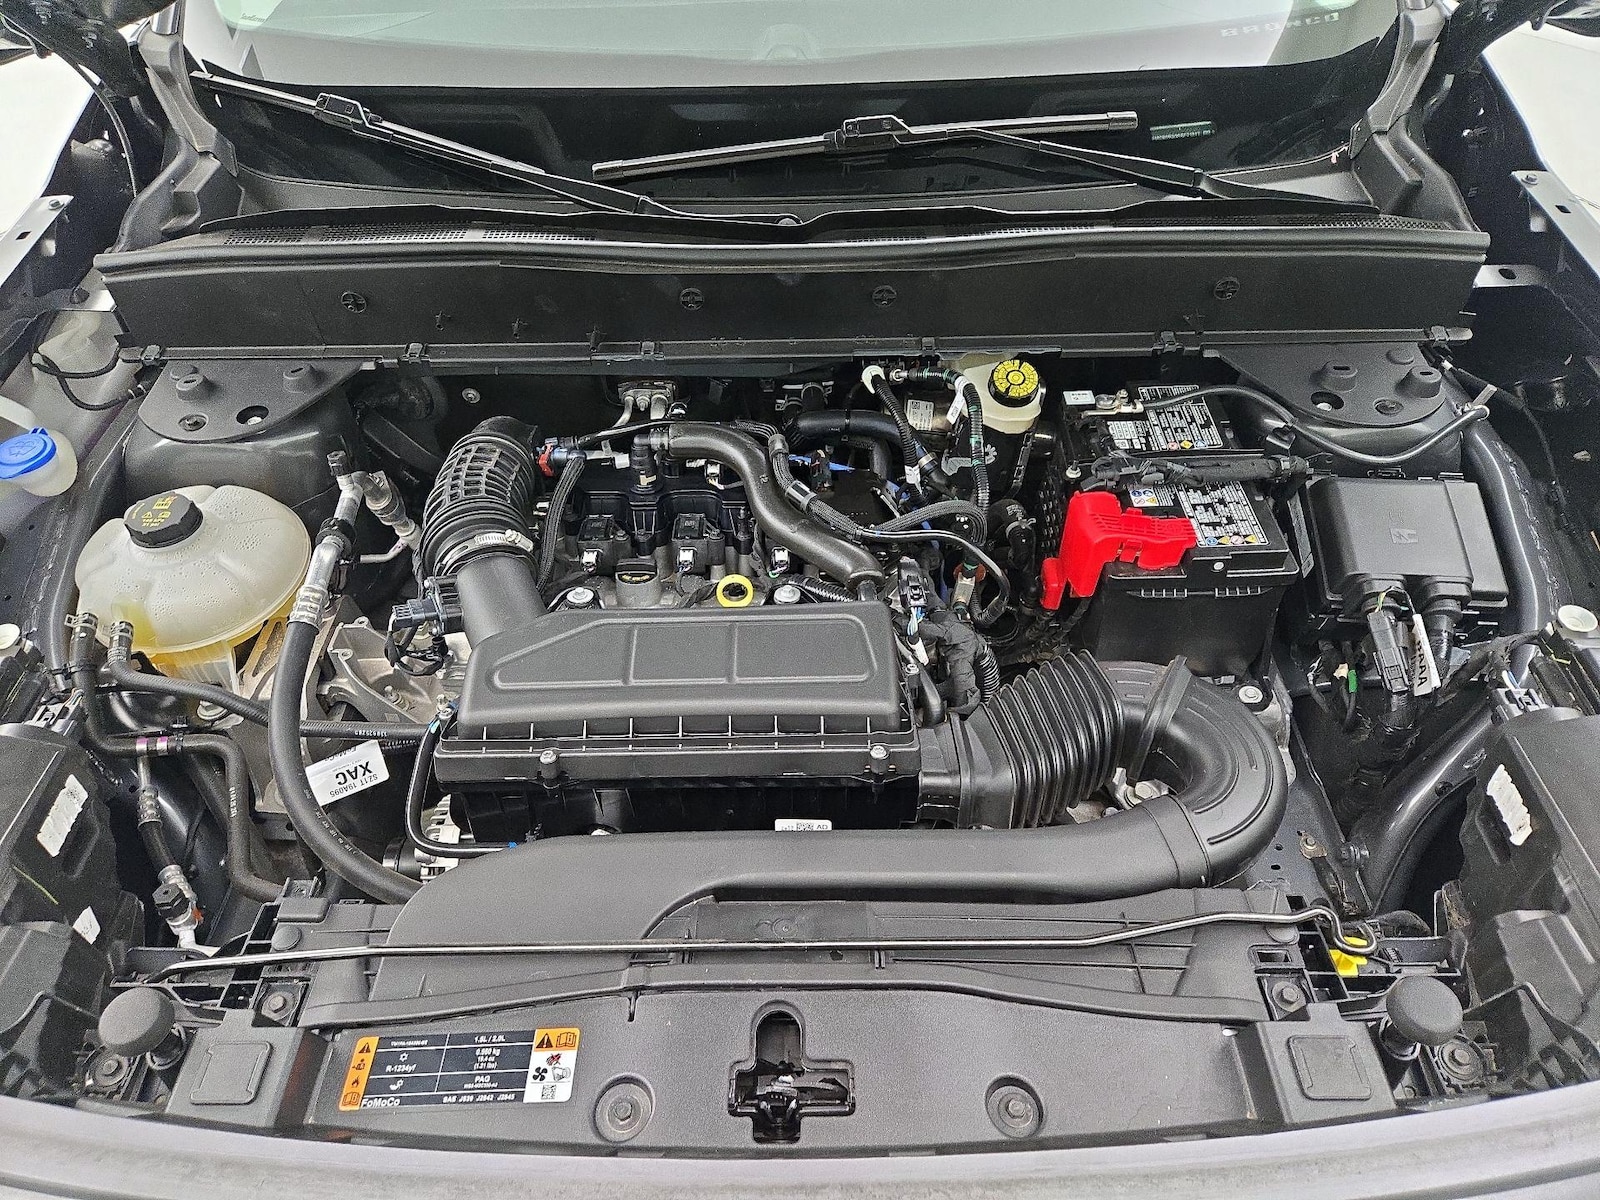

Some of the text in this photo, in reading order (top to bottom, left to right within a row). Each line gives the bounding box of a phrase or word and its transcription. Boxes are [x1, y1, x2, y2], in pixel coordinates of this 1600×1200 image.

[335, 761, 373, 786] XAC
[385, 1063, 417, 1073] R-1234yf
[360, 1097, 401, 1109] FoMoCo
